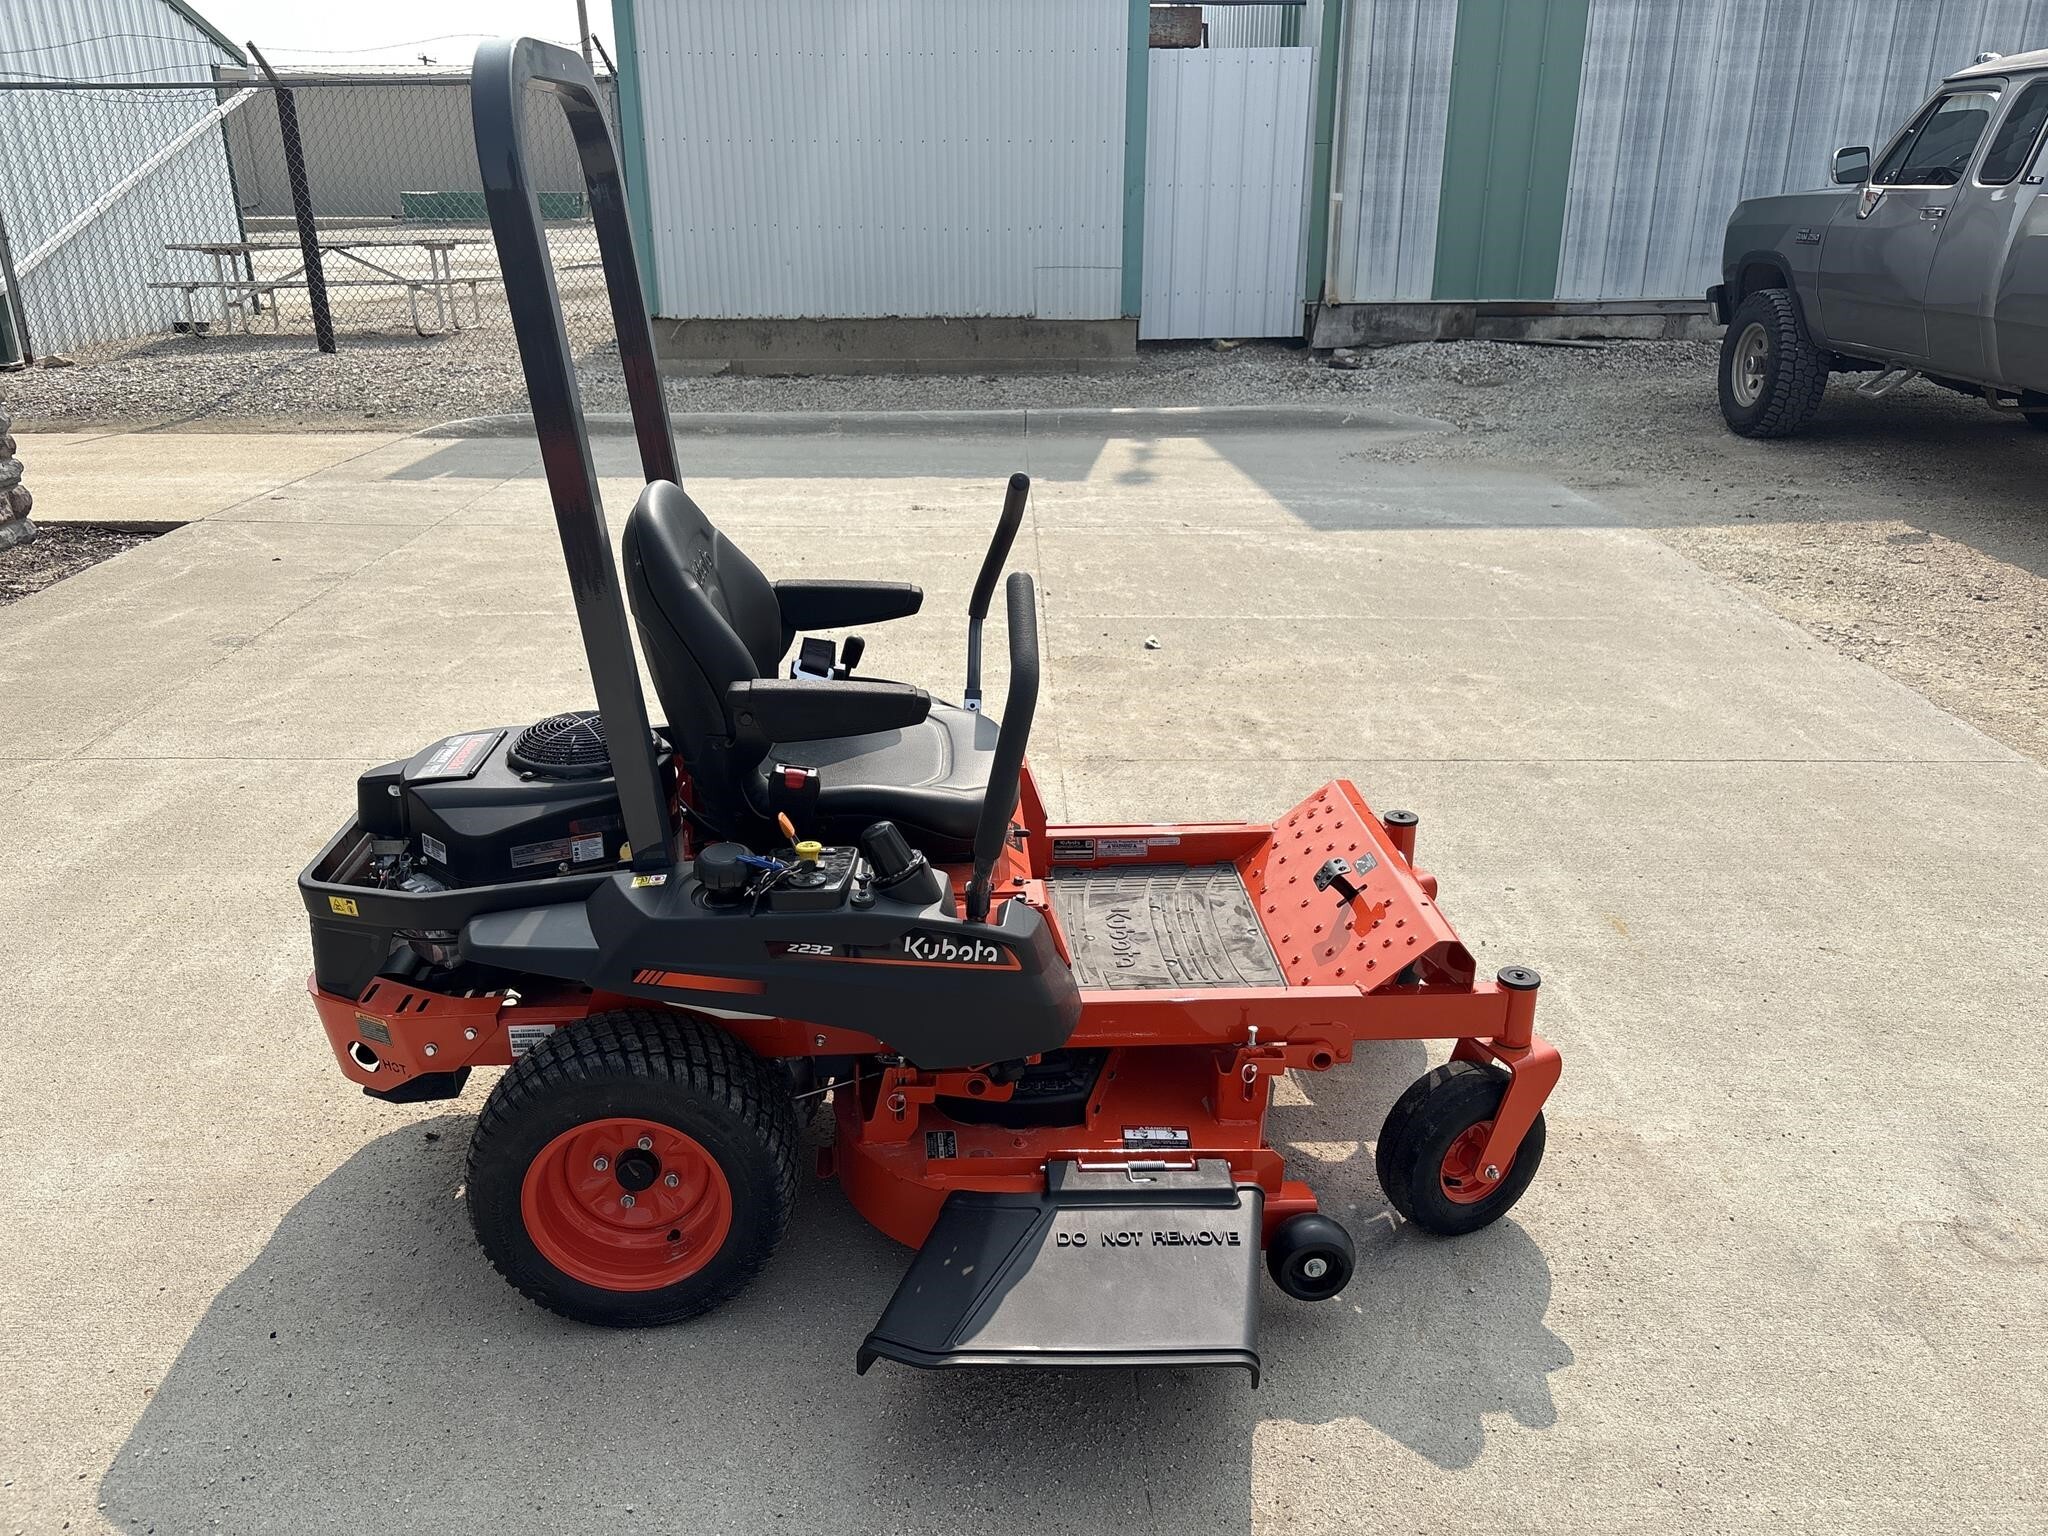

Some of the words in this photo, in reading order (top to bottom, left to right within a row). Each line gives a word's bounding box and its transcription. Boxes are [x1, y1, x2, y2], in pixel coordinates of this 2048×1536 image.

[1105, 908, 1141, 968] Kubota
[787, 943, 833, 955] Z232
[904, 936, 998, 962] Kubota
[382, 1059, 406, 1075] HOT
[1056, 1232, 1088, 1247] DO
[1100, 1231, 1143, 1247] NOT
[1151, 1231, 1241, 1247] REMOVE
